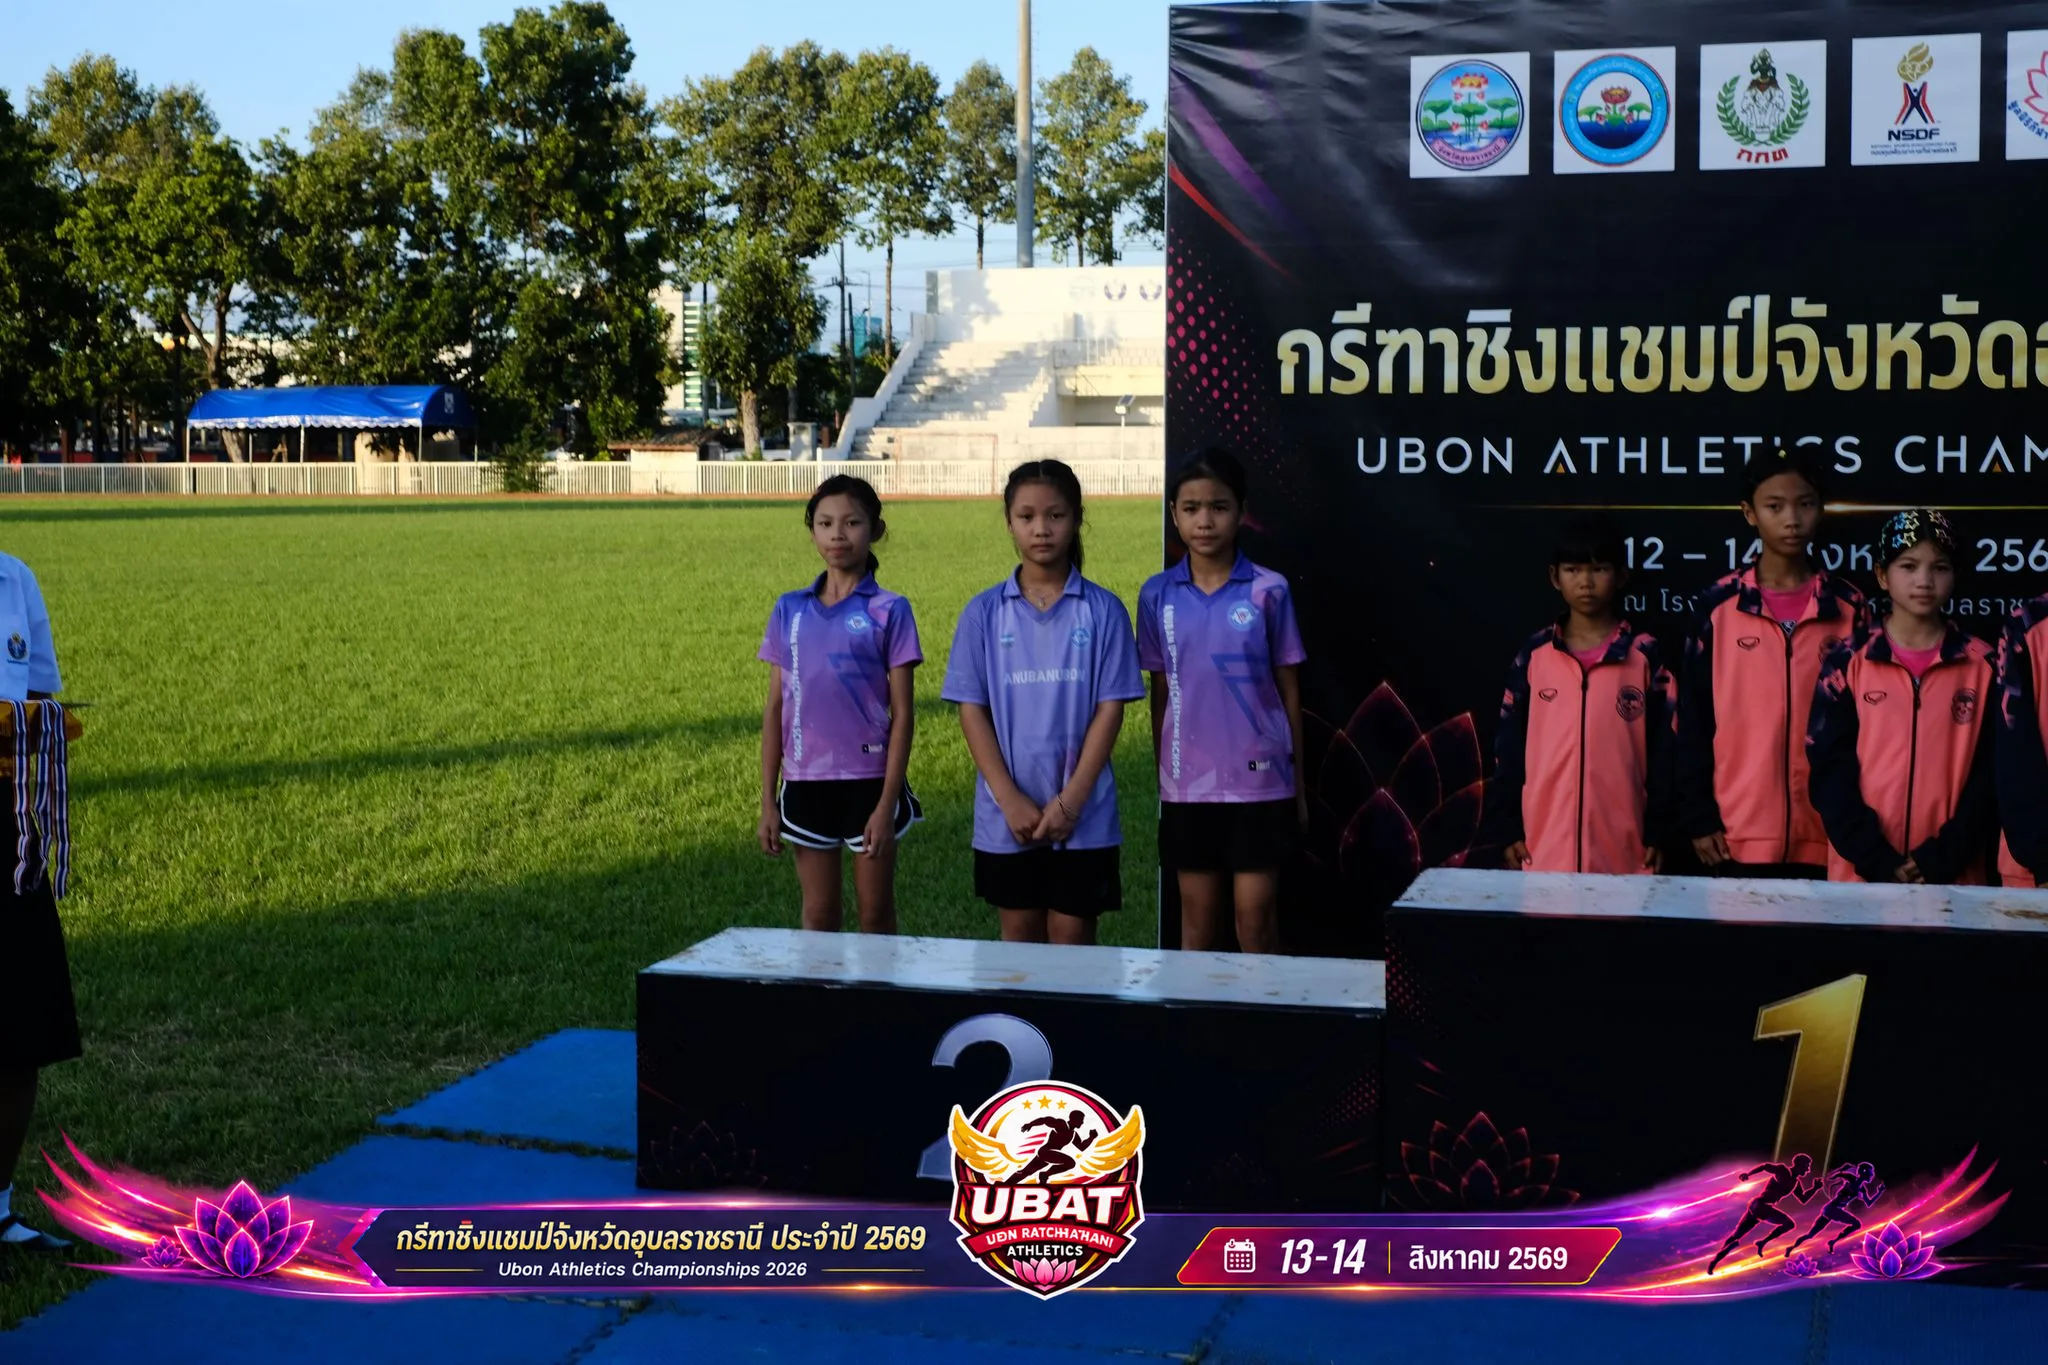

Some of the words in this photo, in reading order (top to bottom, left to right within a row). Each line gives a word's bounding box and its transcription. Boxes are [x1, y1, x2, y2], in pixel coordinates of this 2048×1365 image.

[1888, 128, 1940, 140] NSDF
[1737, 147, 1789, 163] กกท
[1277, 294, 2048, 395] กรีฑาชิงแชมป์จังหวัด
[1357, 437, 1513, 474] UBON
[1544, 435, 1862, 474] ATHLETS
[1624, 537, 1664, 569] 12
[1975, 538, 2048, 572] 256
[1753, 973, 1867, 1182] 1
[916, 1013, 1053, 1182] 2
